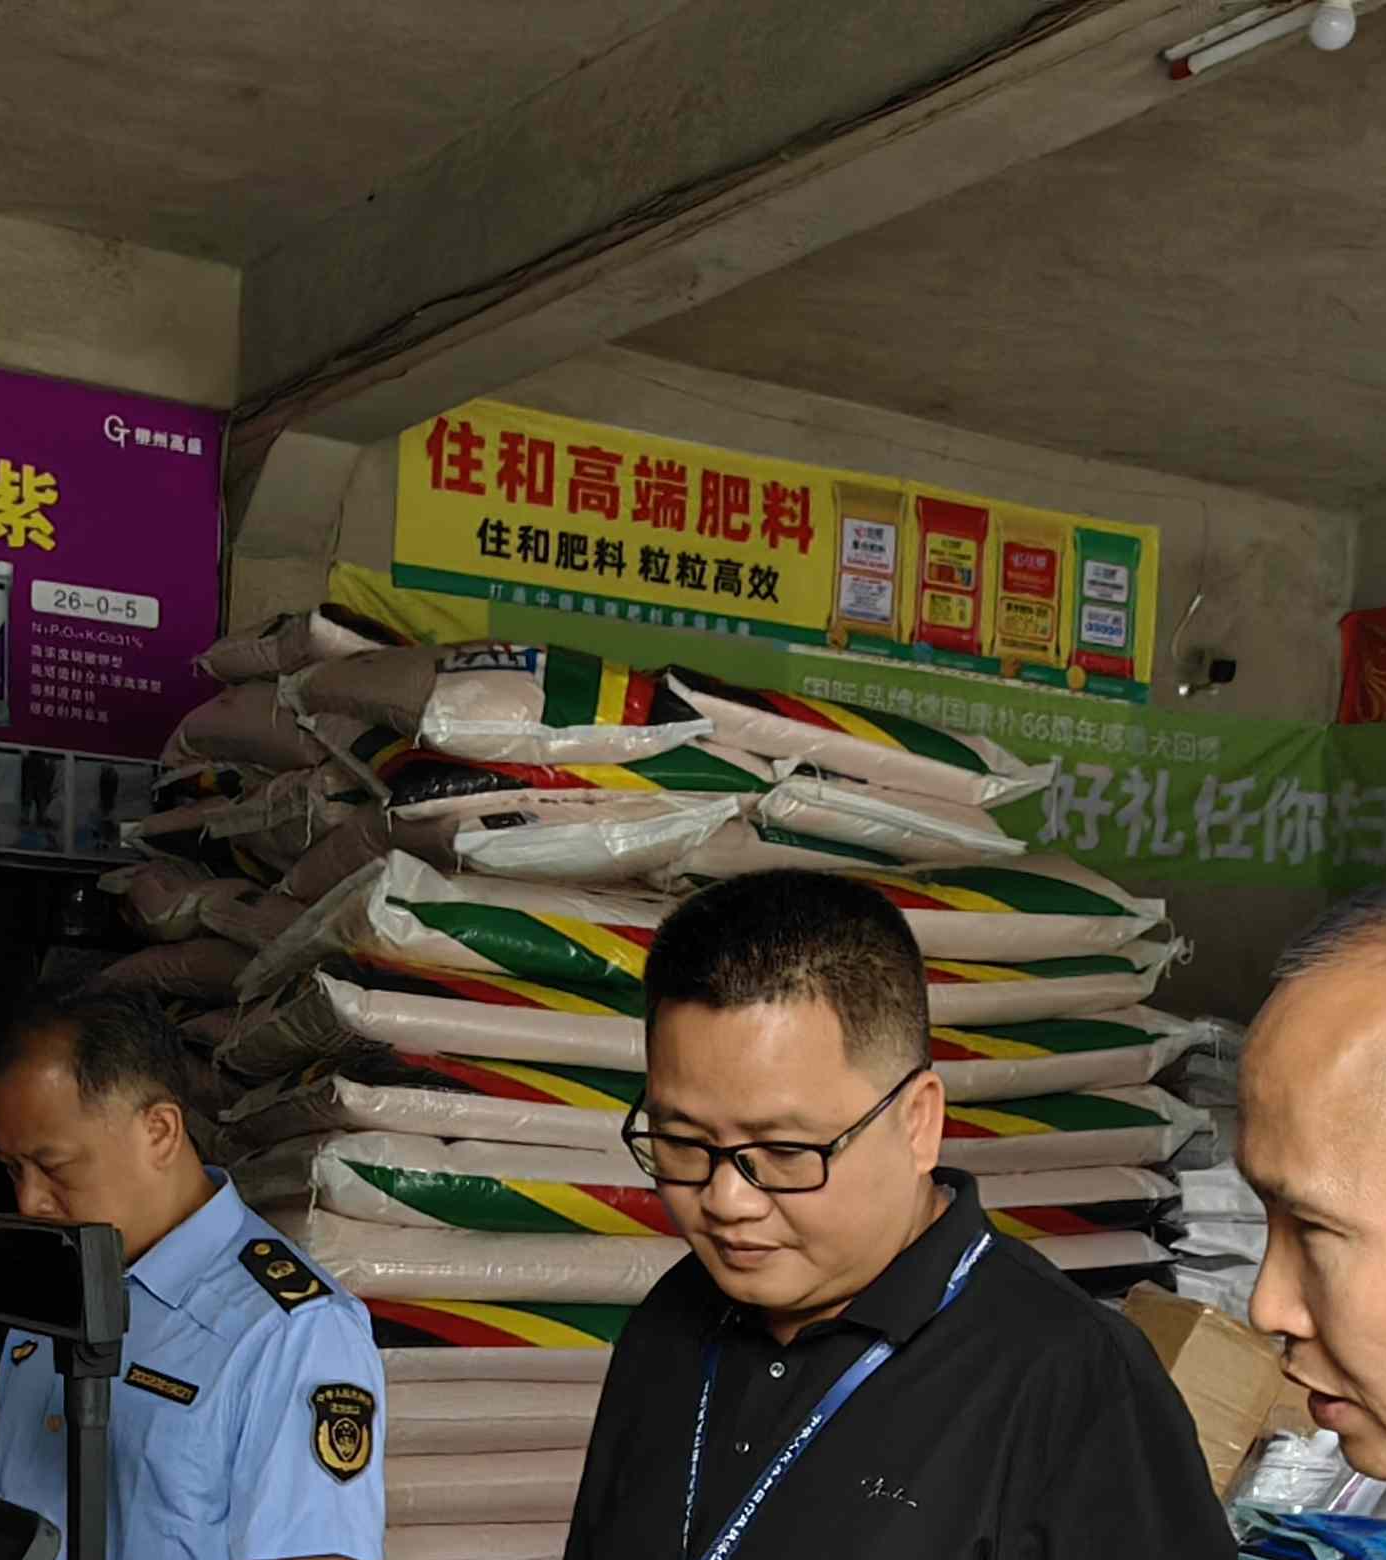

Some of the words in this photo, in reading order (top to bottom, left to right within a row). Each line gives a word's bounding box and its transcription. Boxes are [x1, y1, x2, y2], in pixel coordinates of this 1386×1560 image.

[425, 416, 816, 555] 住和高端肥料
[53, 589, 138, 620] 26-0-5
[476, 517, 627, 579] 住和肥料
[638, 543, 781, 605] 粒粒高效
